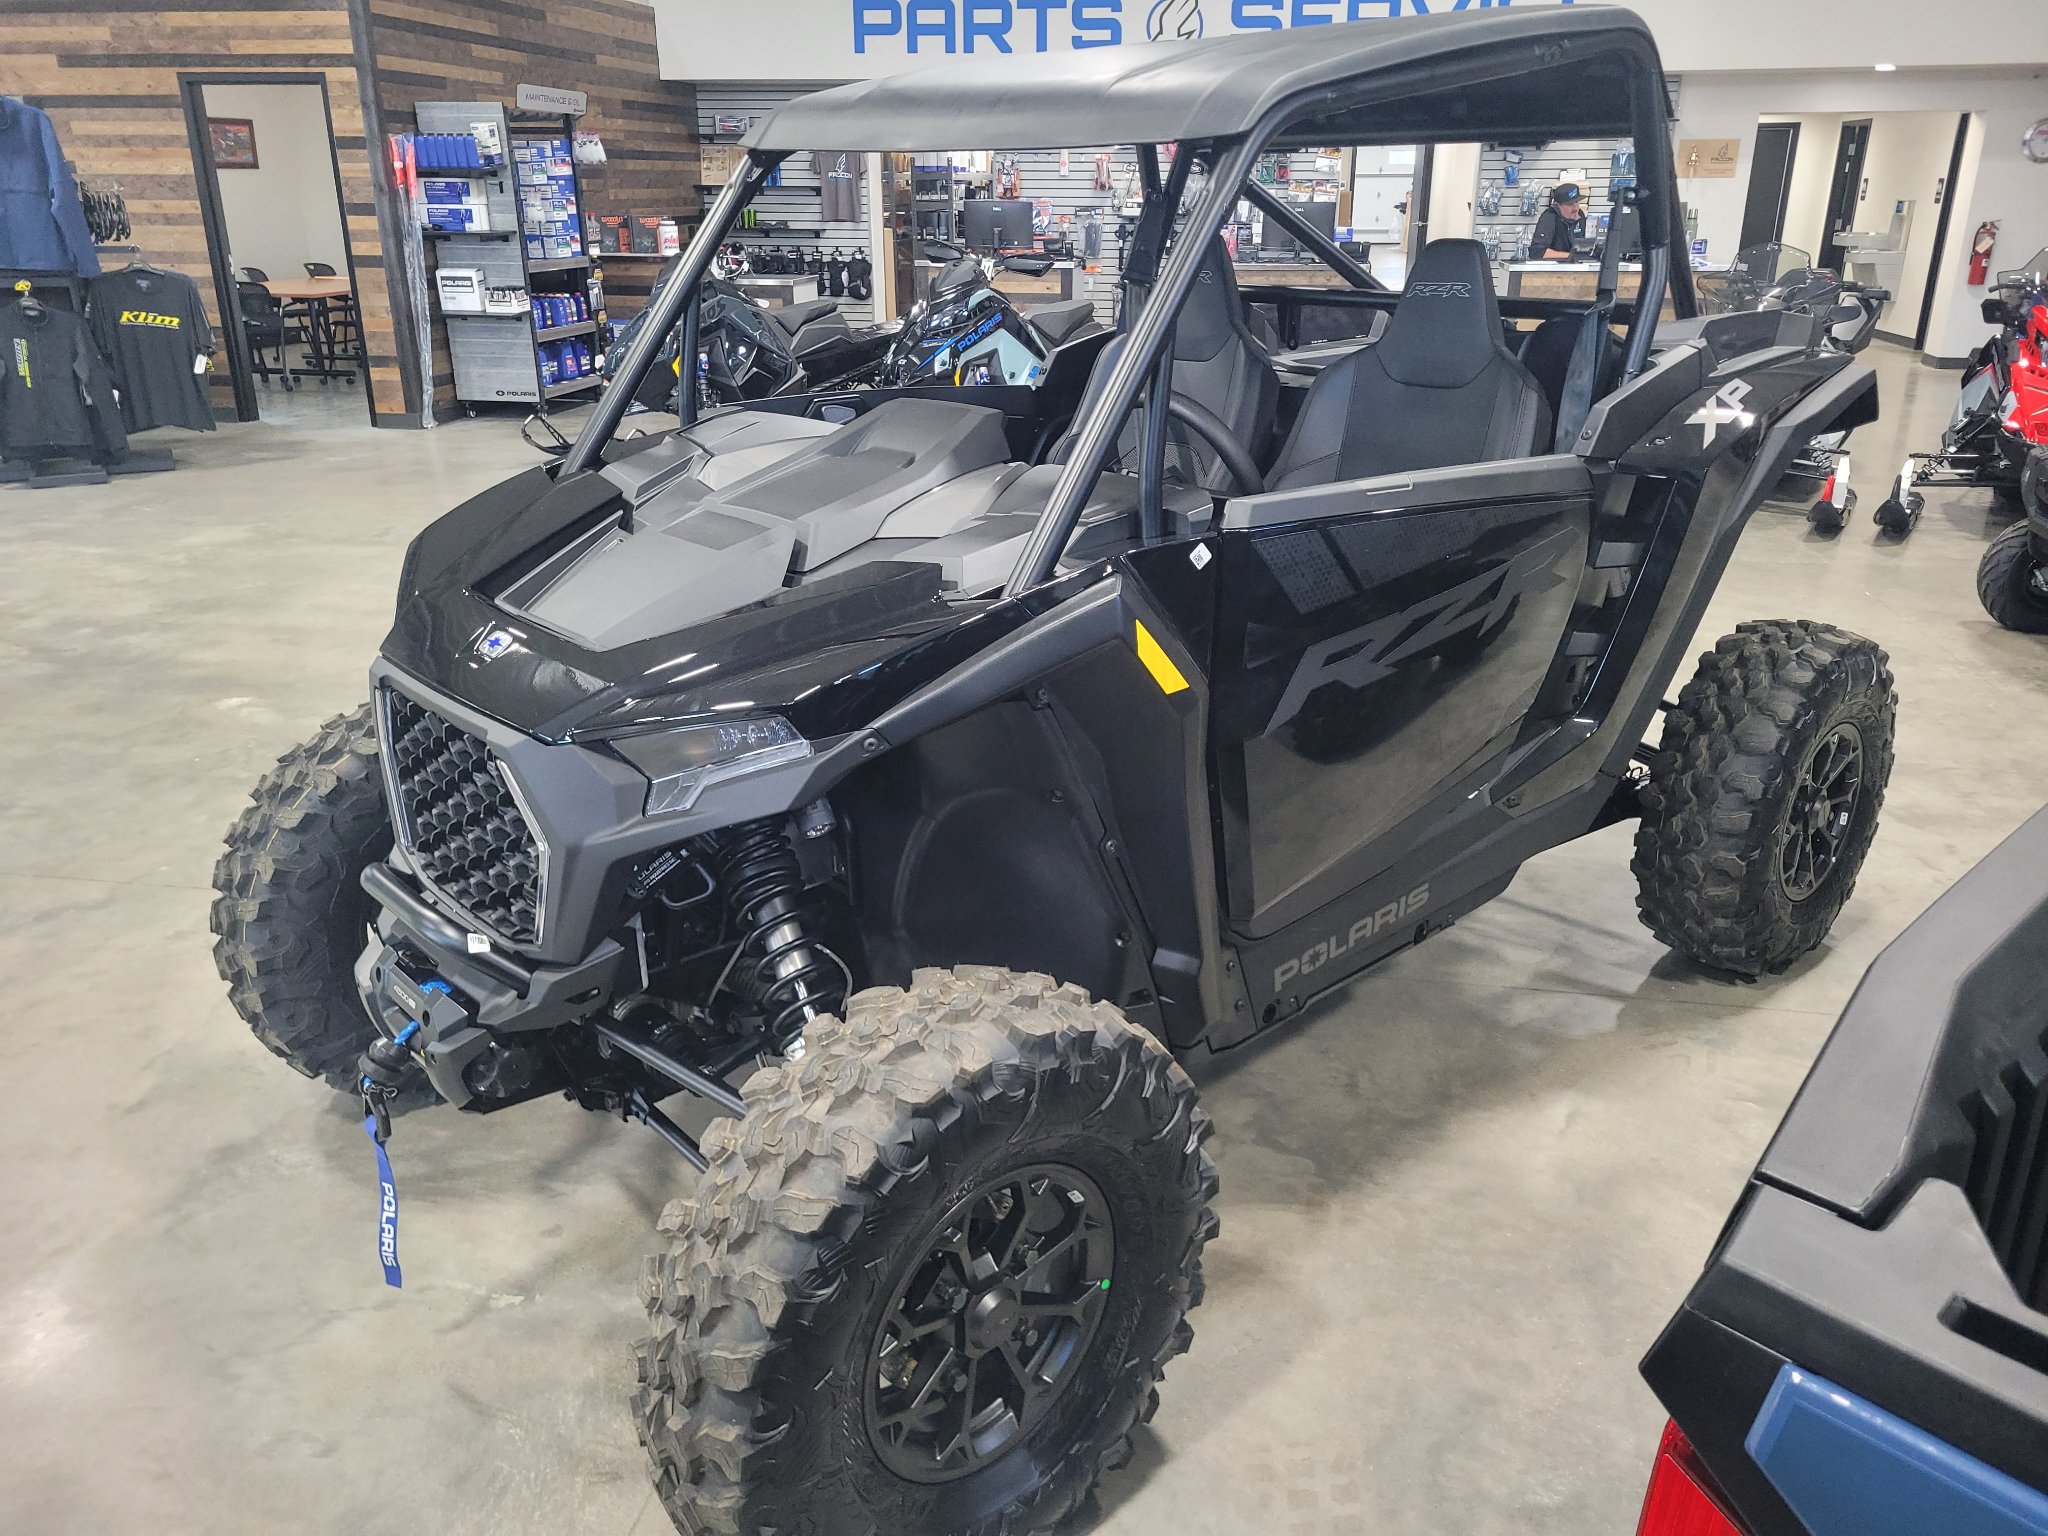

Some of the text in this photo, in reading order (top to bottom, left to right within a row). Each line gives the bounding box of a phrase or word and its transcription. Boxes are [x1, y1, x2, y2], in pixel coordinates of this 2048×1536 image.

[854, 0, 1122, 53] PARTS
[525, 93, 567, 105] MAINTENANCE
[828, 171, 853, 180] FALCON
[1406, 282, 1471, 298] RZR
[120, 310, 180, 327] Klim
[957, 311, 1004, 352] POLARIS
[1684, 378, 1754, 450] XP
[1262, 526, 1583, 739] RZR
[1273, 882, 1430, 993] POLARIS
[381, 1181, 397, 1268] POLARIS
